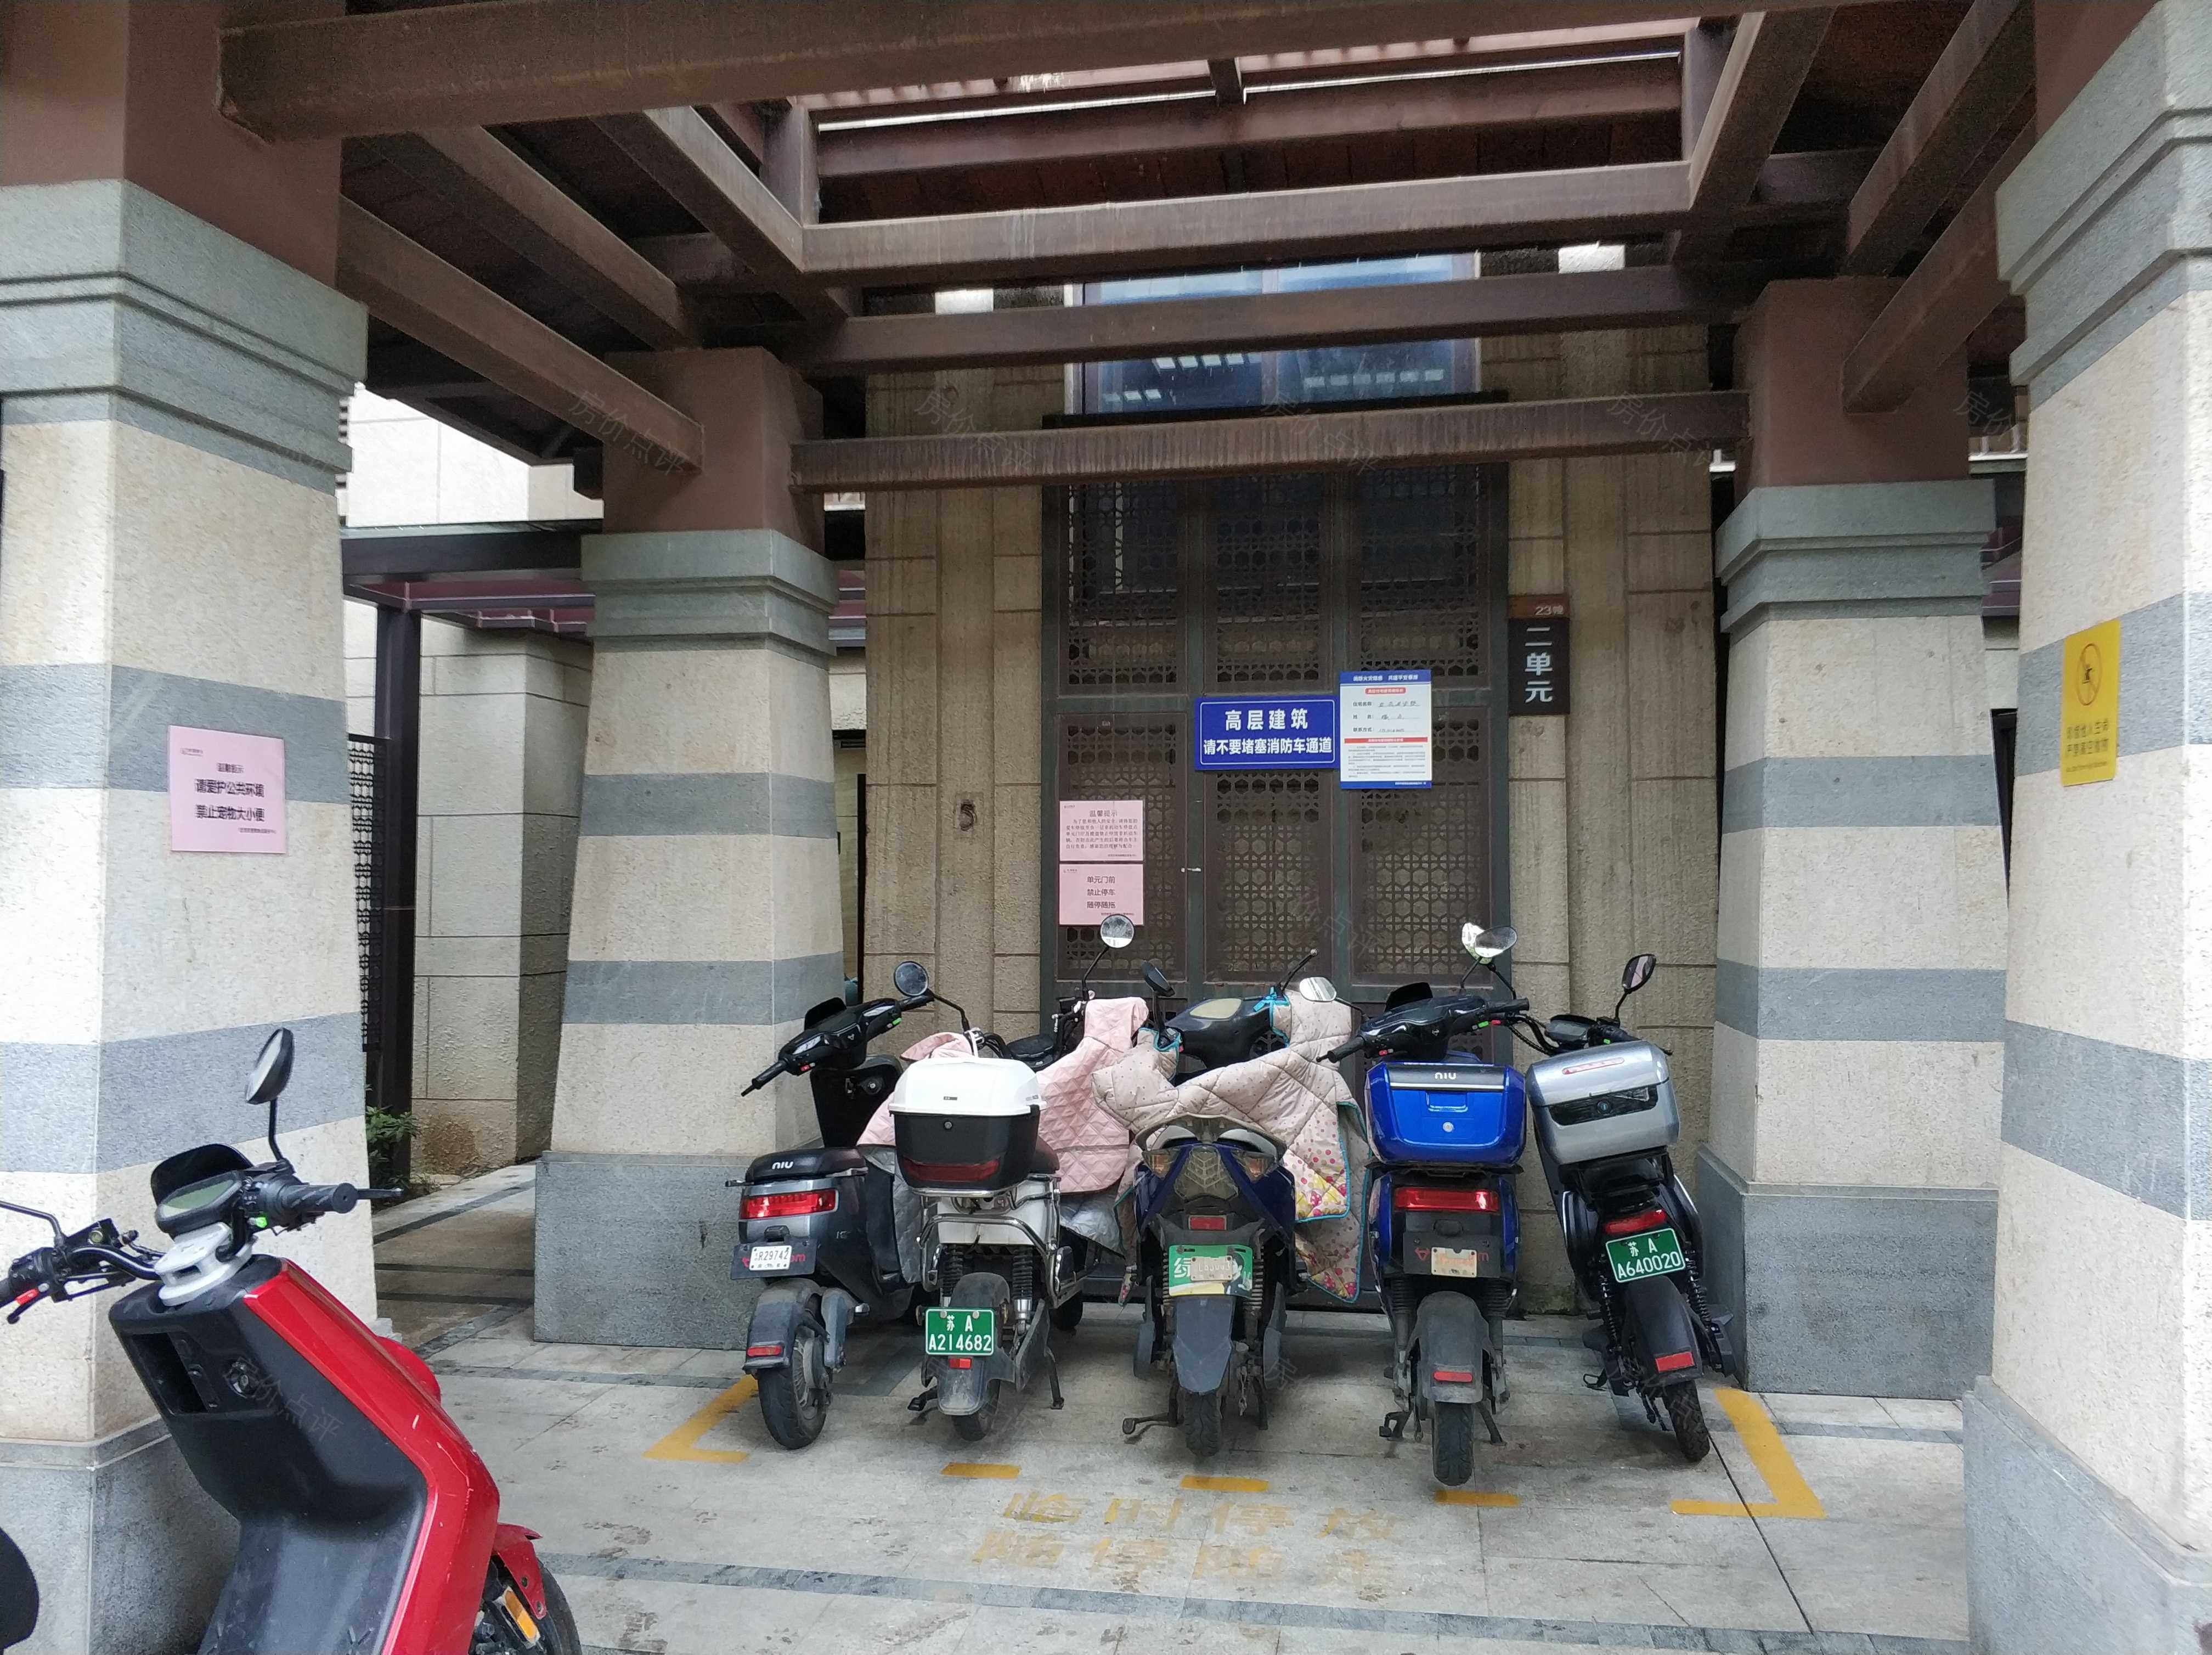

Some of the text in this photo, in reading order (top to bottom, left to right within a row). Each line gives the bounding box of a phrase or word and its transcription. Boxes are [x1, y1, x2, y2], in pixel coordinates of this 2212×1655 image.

[1525, 627, 1553, 703] 二单元
[1225, 708, 1308, 730] 高层建筑
[1203, 737, 1333, 755] 请不要堵塞消防车通道
[195, 779, 264, 797] 请爱护公共环境
[195, 804, 264, 822] 禁止宠物大小便
[758, 1250, 789, 1261] R29742
[1628, 1238, 1658, 1257] 苏 A
[1617, 1251, 1681, 1279] A640020
[946, 1315, 973, 1332] 苏 A
[928, 1333, 992, 1351] A214682
